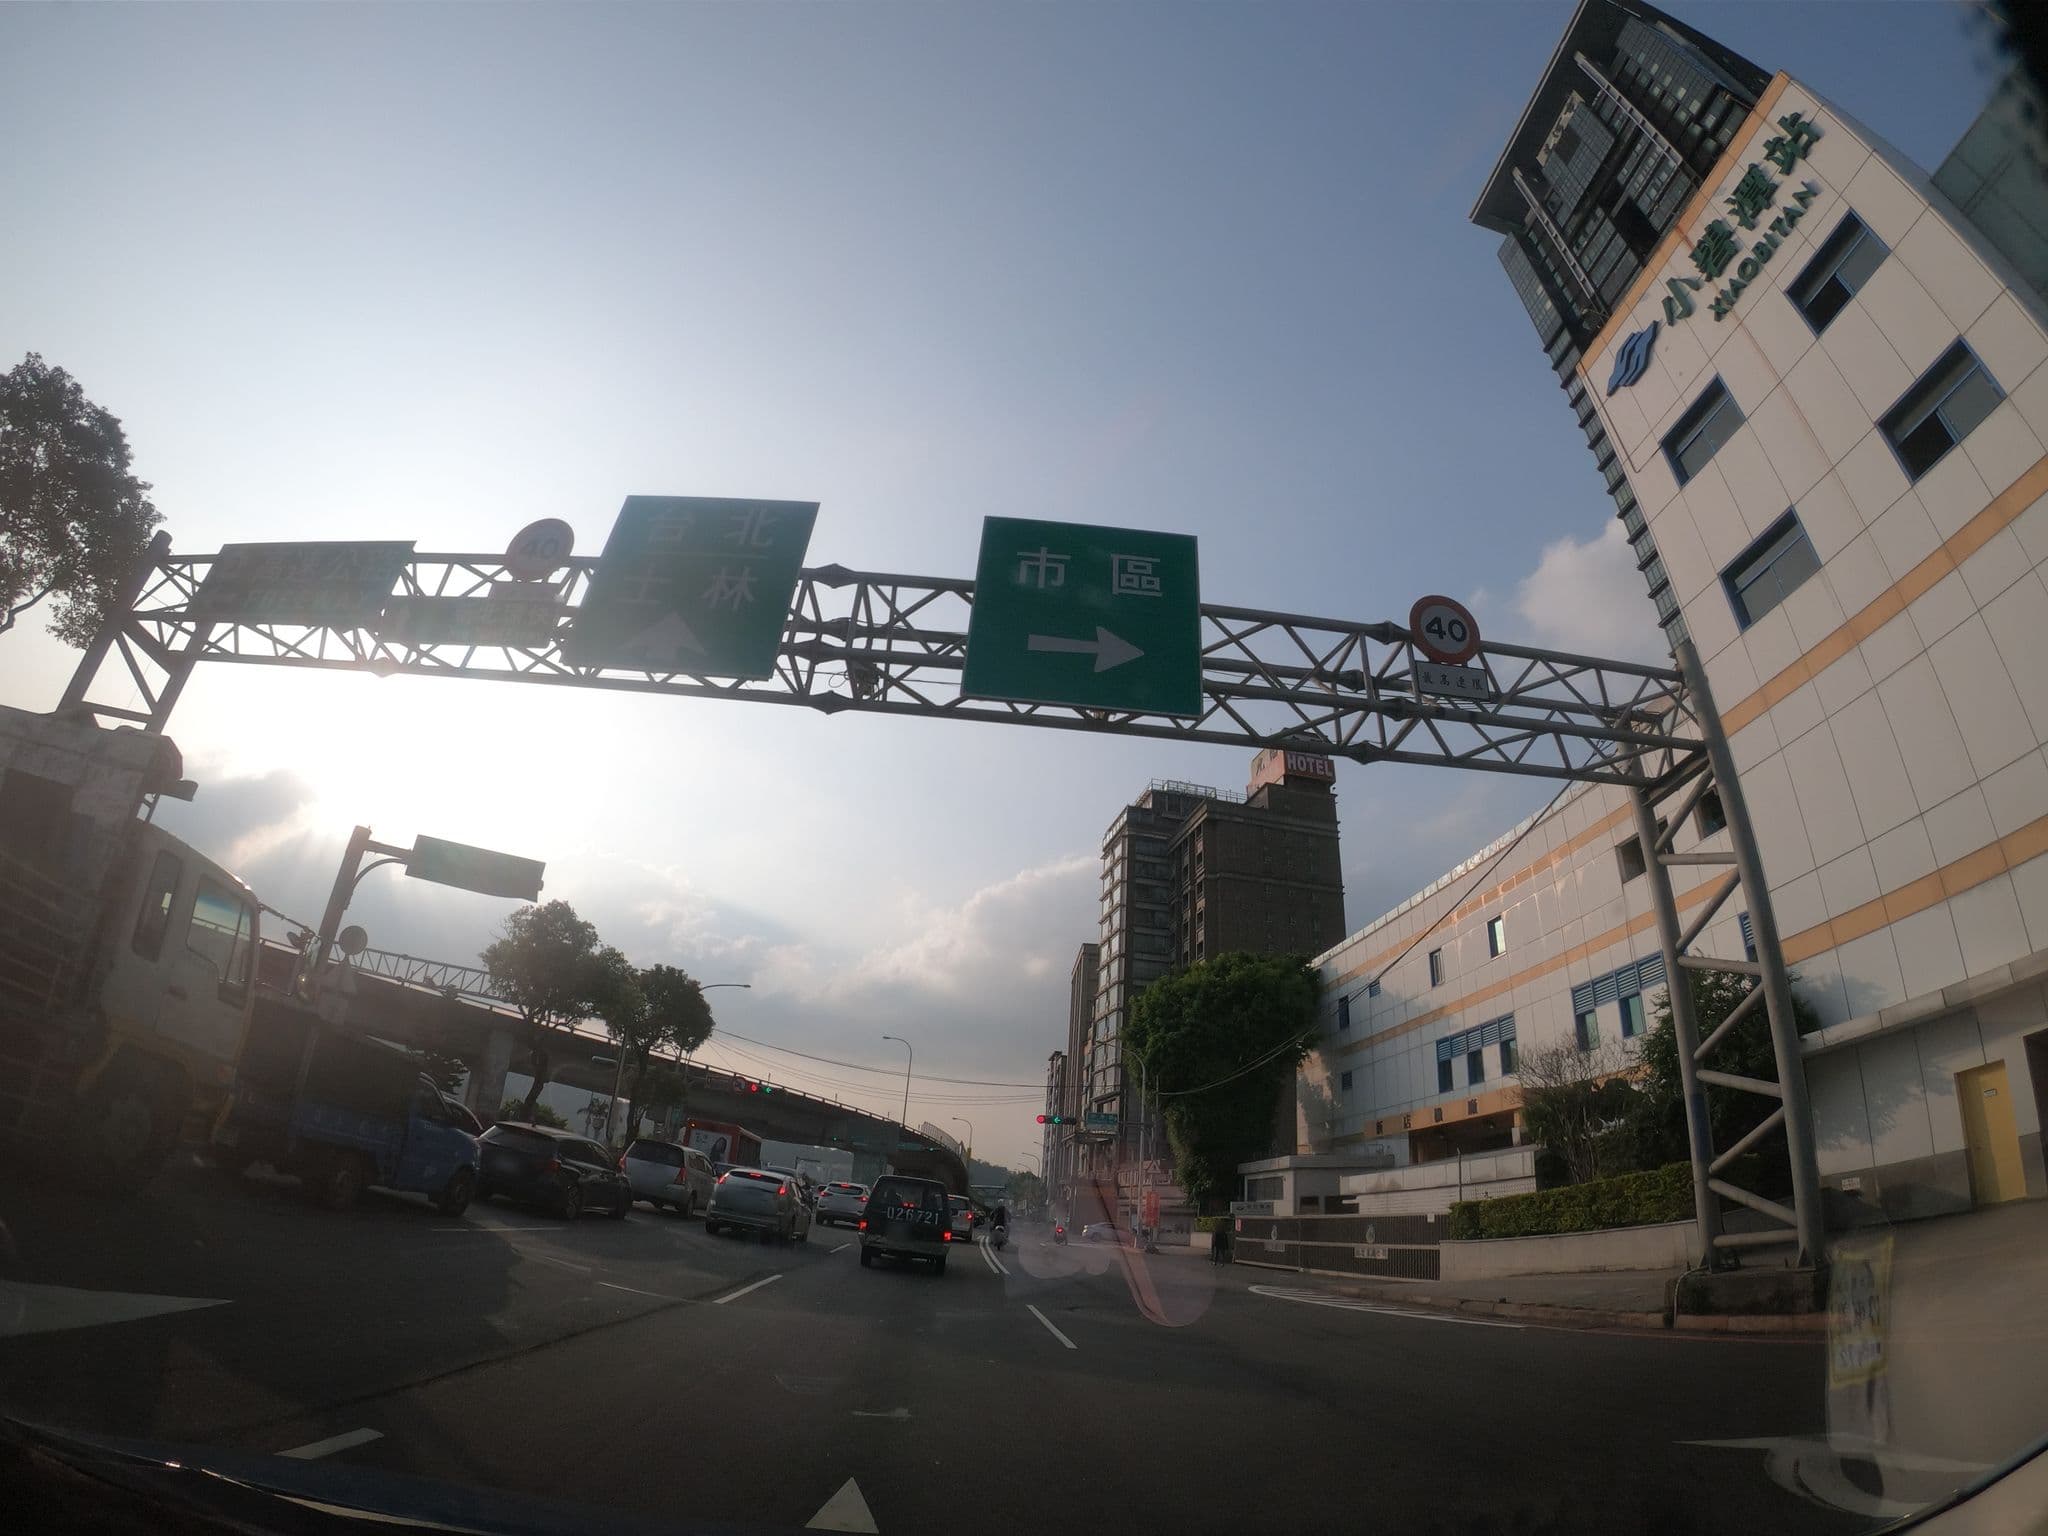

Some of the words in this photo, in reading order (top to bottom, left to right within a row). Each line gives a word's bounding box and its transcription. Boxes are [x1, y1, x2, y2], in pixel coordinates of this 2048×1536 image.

[1661, 111, 1822, 327] 小碧潭站
[1706, 181, 1820, 323] XIAOBITAN
[647, 504, 781, 547] 台北
[518, 538, 560, 560] 40
[615, 564, 759, 611] 士林
[1016, 546, 1163, 597] 市區
[1425, 616, 1468, 642] 40
[1423, 671, 1484, 691] 最高速限
[1287, 753, 1333, 777] HOTEL
